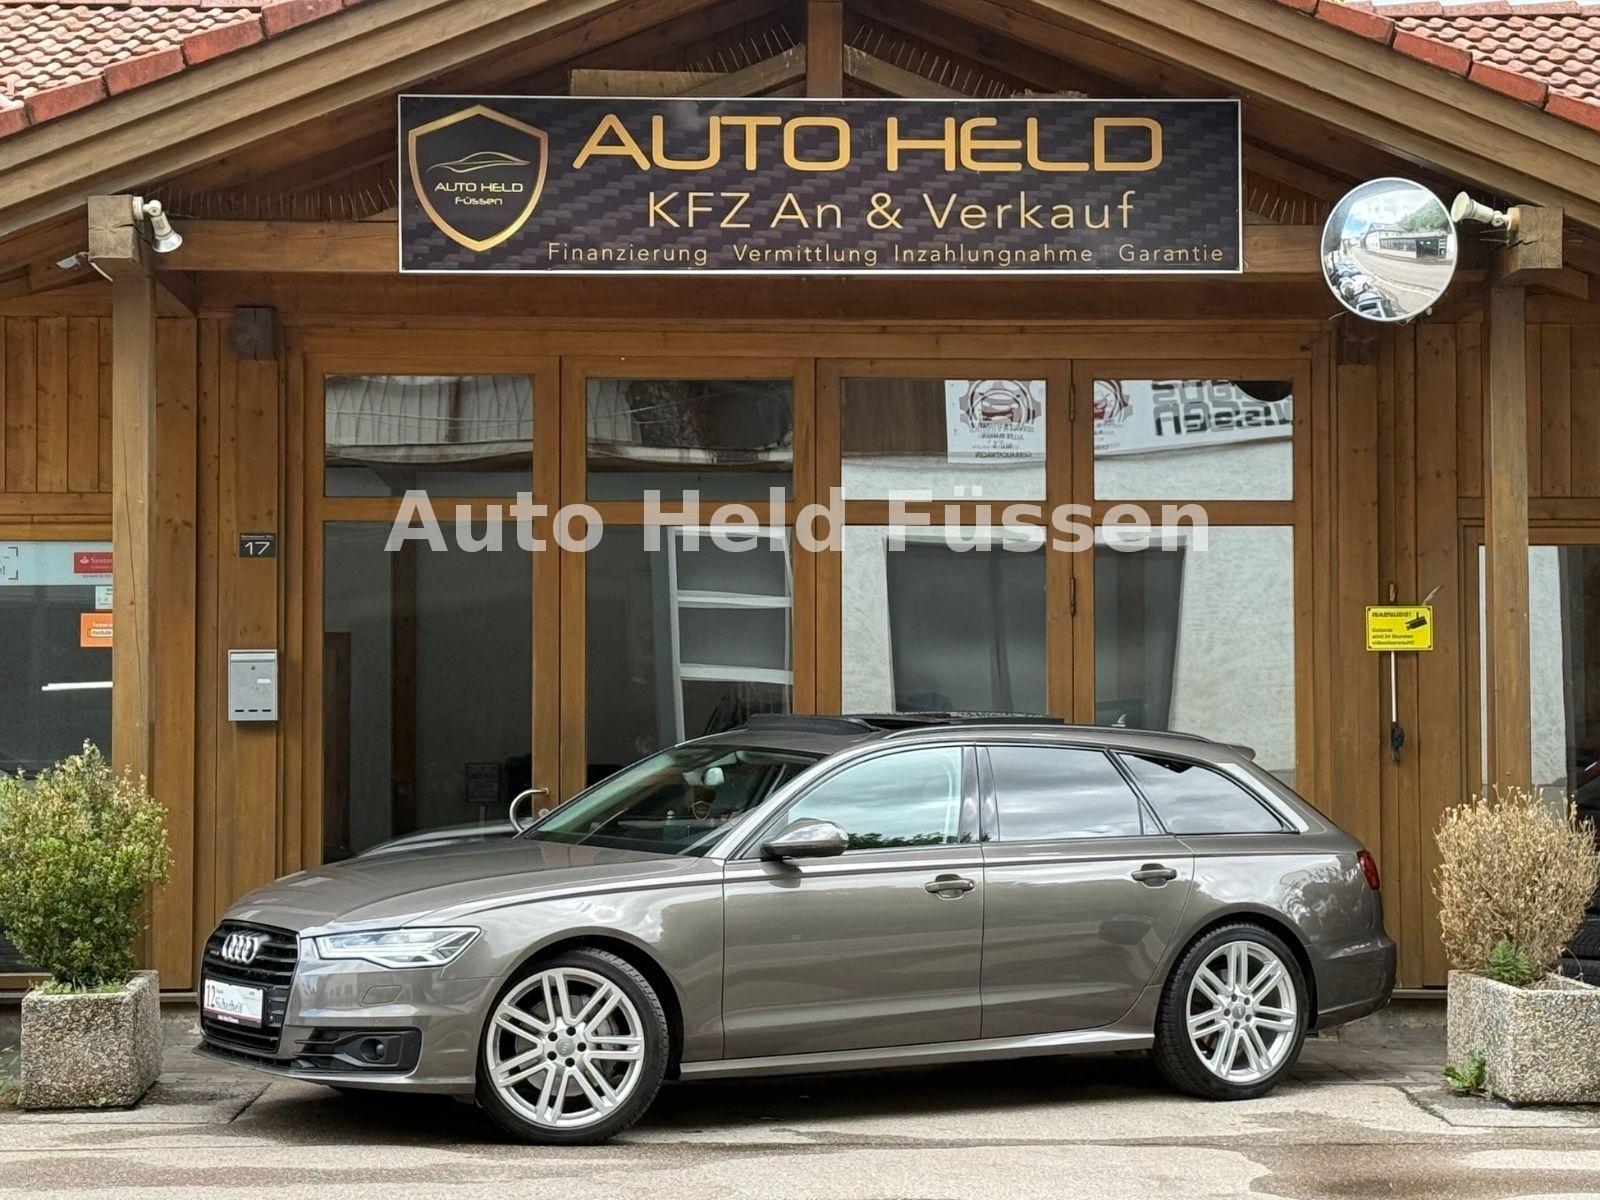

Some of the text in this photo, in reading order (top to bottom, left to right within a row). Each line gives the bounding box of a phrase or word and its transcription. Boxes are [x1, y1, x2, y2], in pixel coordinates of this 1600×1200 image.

[572, 113, 1163, 172] AUTO HELD
[434, 182, 524, 193] AUTO HELD
[454, 196, 503, 206] Füssen
[648, 190, 1137, 230] KFZ An & Verkauf
[548, 242, 1224, 267] Finanzierung Vermittlung Inzahlungnahme Garantie
[244, 541, 270, 555] 17
